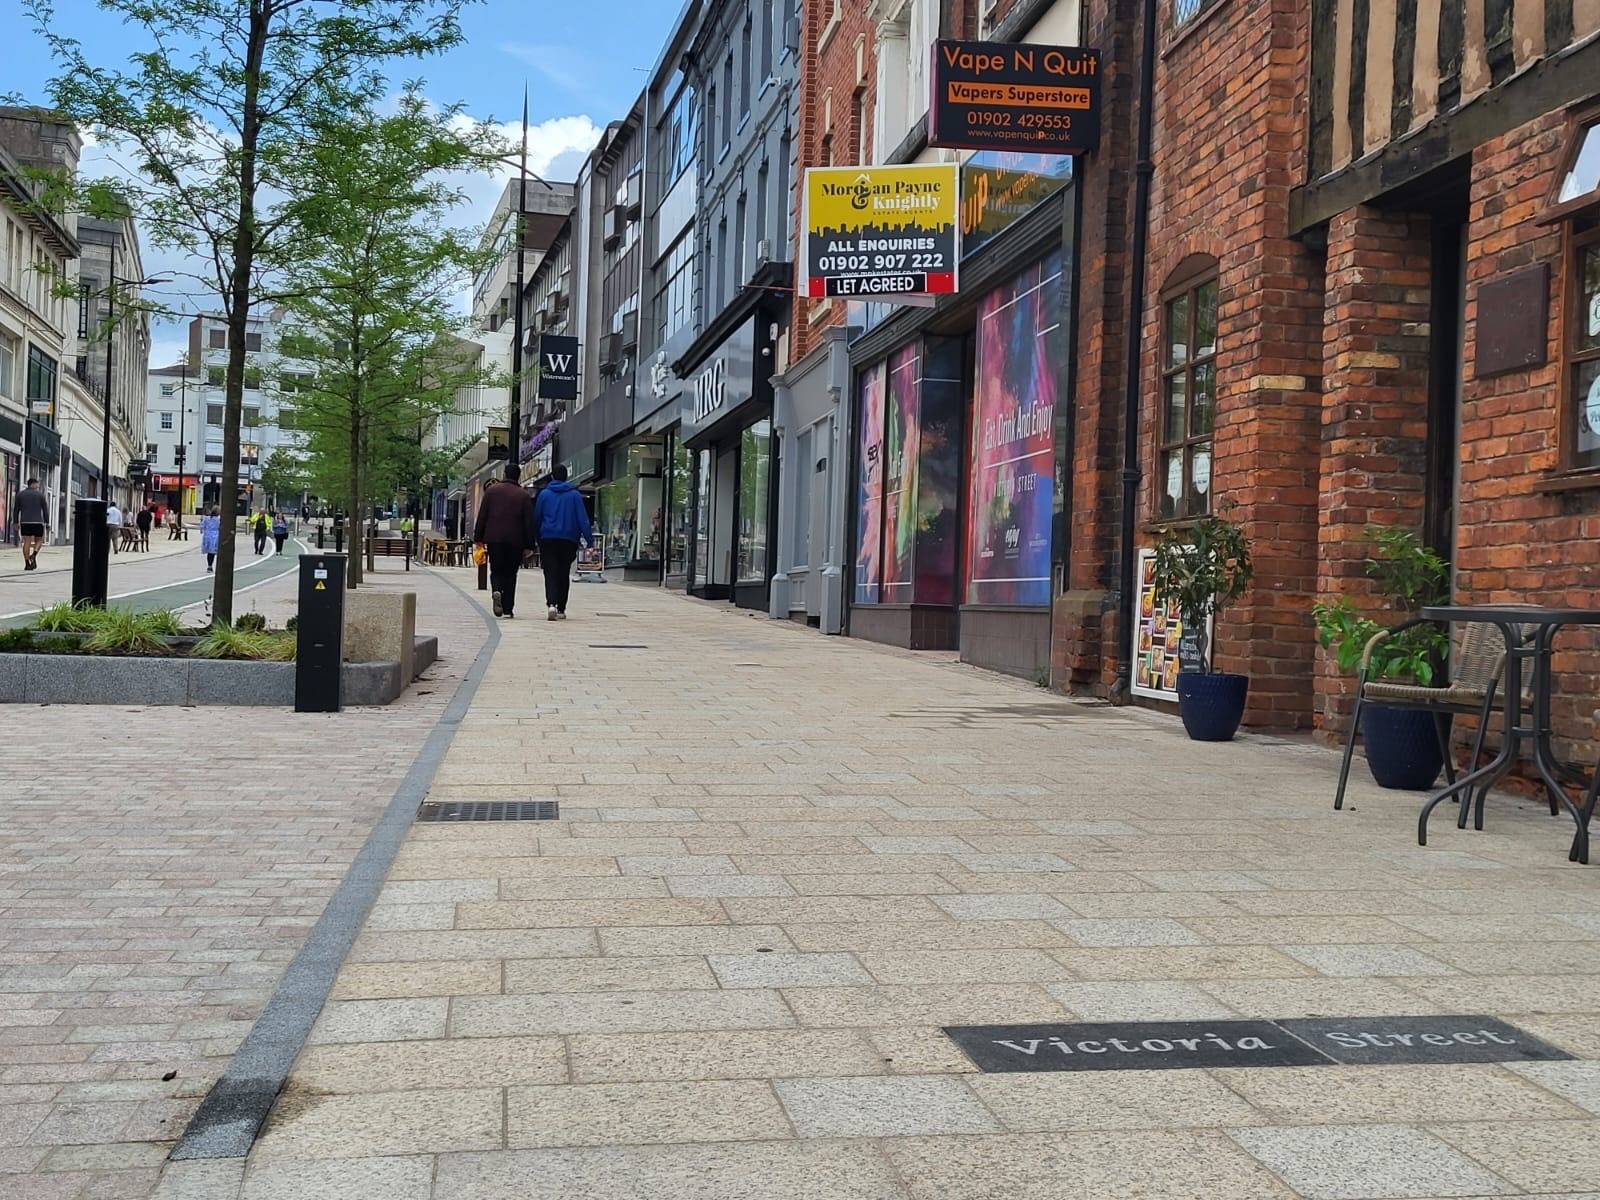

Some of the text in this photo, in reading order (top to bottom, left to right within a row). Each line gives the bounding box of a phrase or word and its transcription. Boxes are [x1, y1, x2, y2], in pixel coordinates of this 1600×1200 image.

[943, 46, 1097, 76] Vape N Quit
[951, 84, 1089, 104] Vapers Superstore
[967, 111, 1071, 129] 01902 429553
[895, 181, 941, 196] Payne
[872, 193, 941, 210] Knightly
[828, 238, 935, 252] ALL ENQUIRIES
[819, 253, 943, 271] 01902 907 222
[836, 276, 915, 294] LET AGREED
[545, 353, 573, 373] W
[693, 358, 723, 424] MRG
[998, 409, 1017, 447] Drink
[1016, 405, 1031, 440] And
[1031, 399, 1053, 442] Enjoy
[1017, 473, 1037, 493] STREET
[992, 1030, 1516, 1055] Victoria Street
